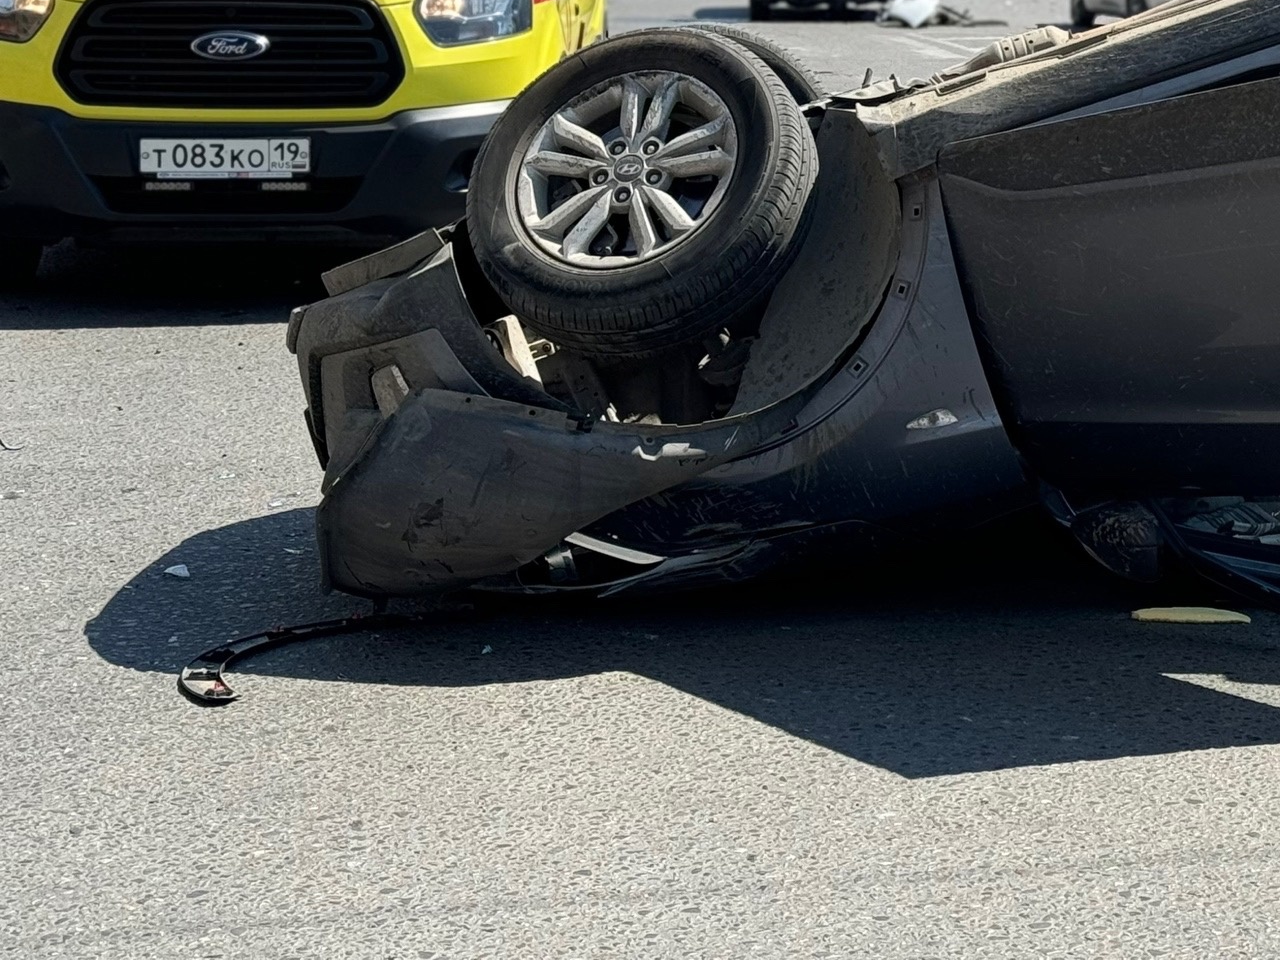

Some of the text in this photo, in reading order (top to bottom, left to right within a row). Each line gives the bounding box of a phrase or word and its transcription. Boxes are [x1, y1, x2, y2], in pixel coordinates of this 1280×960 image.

[207, 37, 248, 54] Ford
[152, 142, 300, 169] Т083КО 19
[271, 161, 291, 169] RUS
